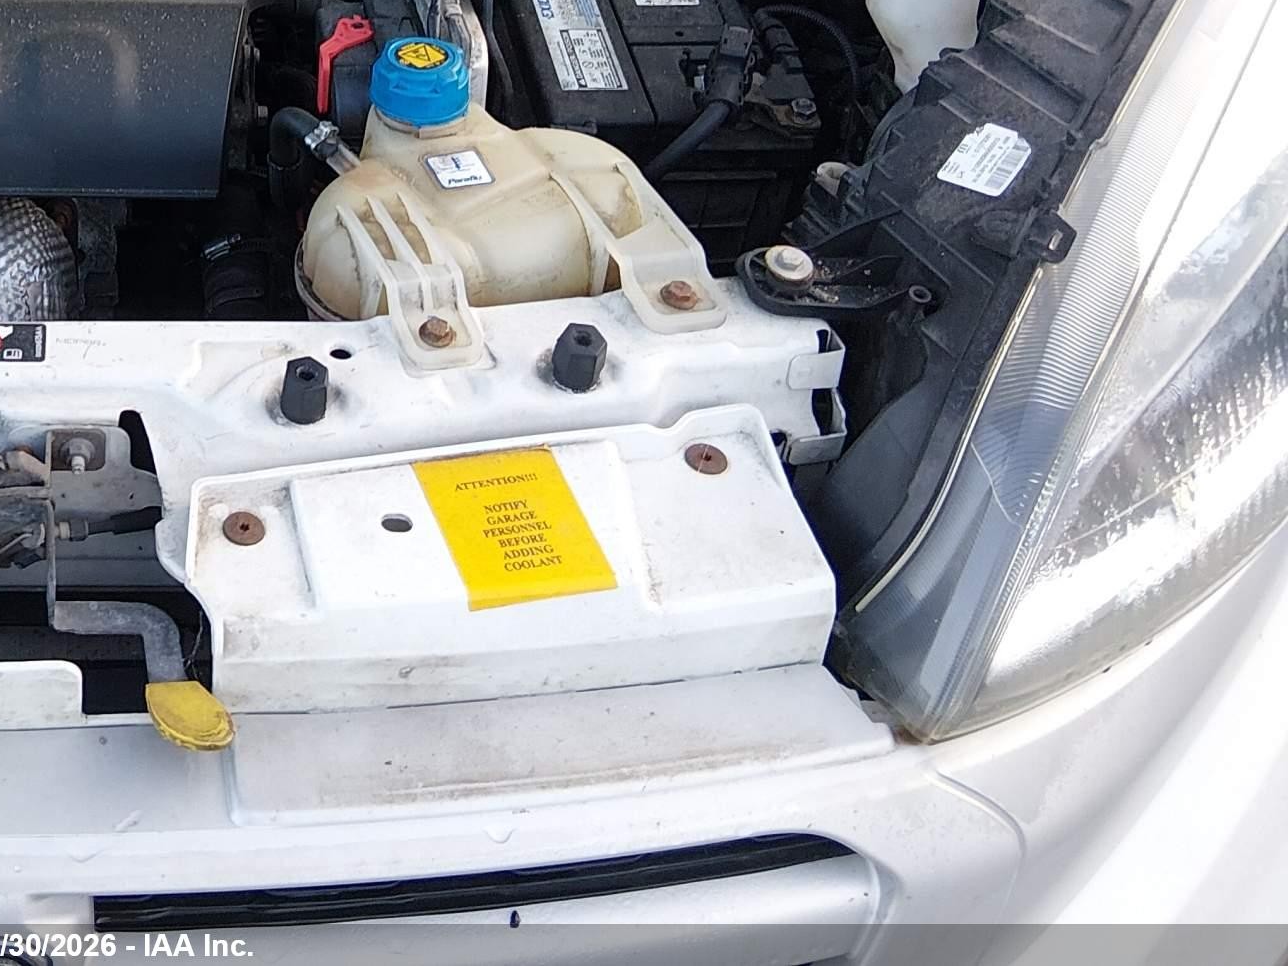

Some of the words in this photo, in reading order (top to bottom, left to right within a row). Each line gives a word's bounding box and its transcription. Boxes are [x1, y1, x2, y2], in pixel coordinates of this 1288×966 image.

[455, 473, 538, 491] ATTENTION!!!
[484, 499, 528, 514] NOTIFY
[487, 511, 537, 525] GARAGE
[483, 520, 552, 538] PERSONNEL
[498, 533, 547, 548] BEFORE
[503, 544, 554, 560] ADDING
[504, 555, 562, 572] COOLANT
